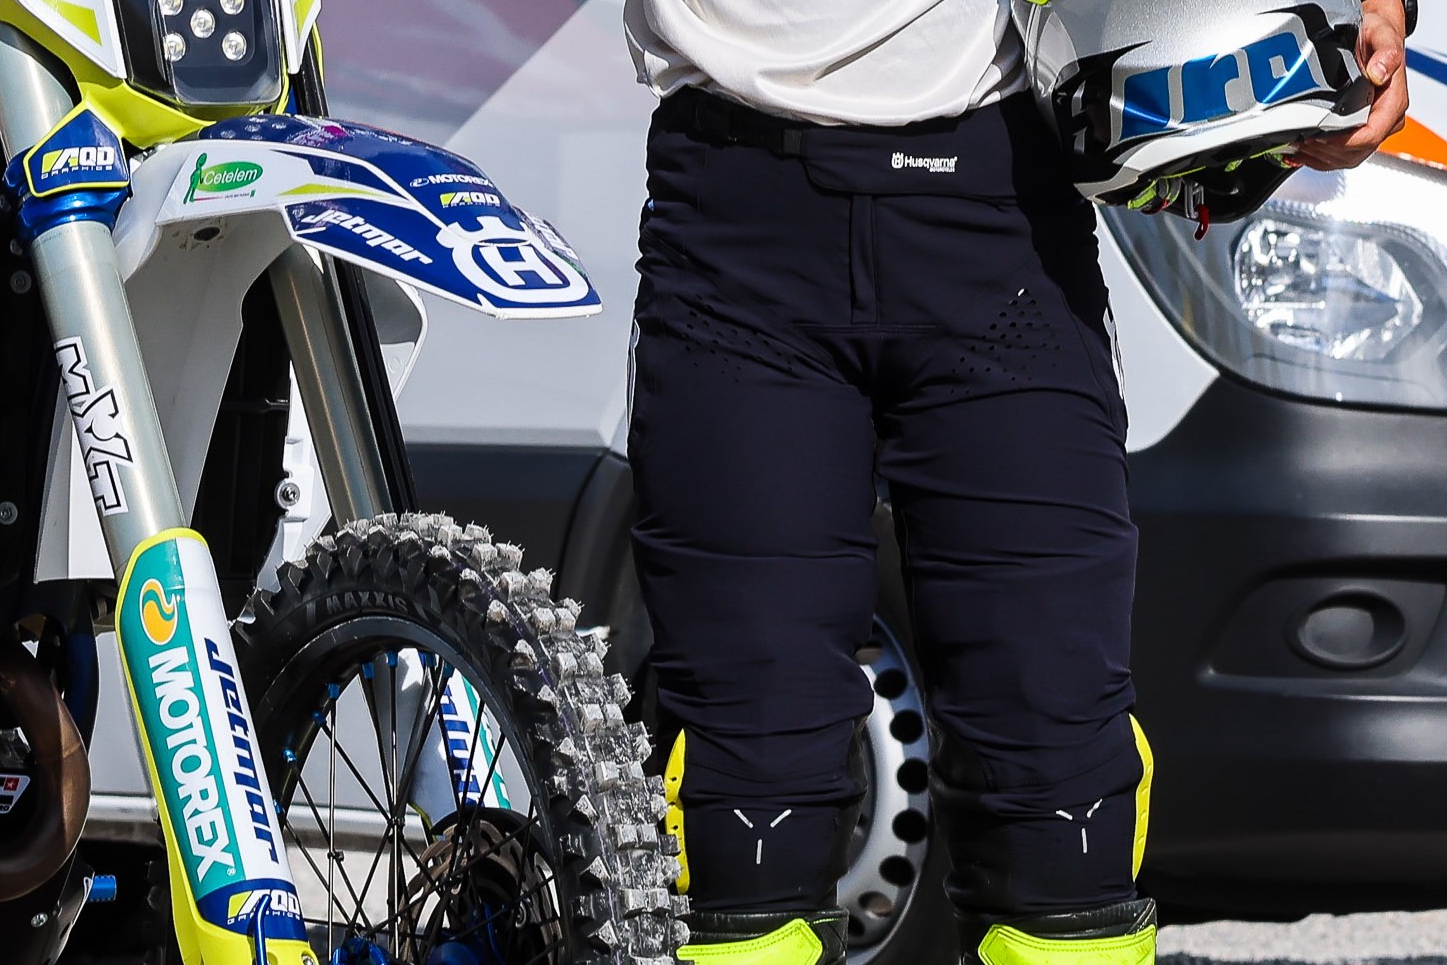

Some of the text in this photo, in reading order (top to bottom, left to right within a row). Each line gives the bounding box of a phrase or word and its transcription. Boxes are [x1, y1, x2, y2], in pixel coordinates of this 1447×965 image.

[904, 155, 956, 169] Husqvarna
[203, 167, 258, 186] Cetelem
[326, 591, 409, 614] MAXXIS
[148, 646, 235, 883] MOTOREX
